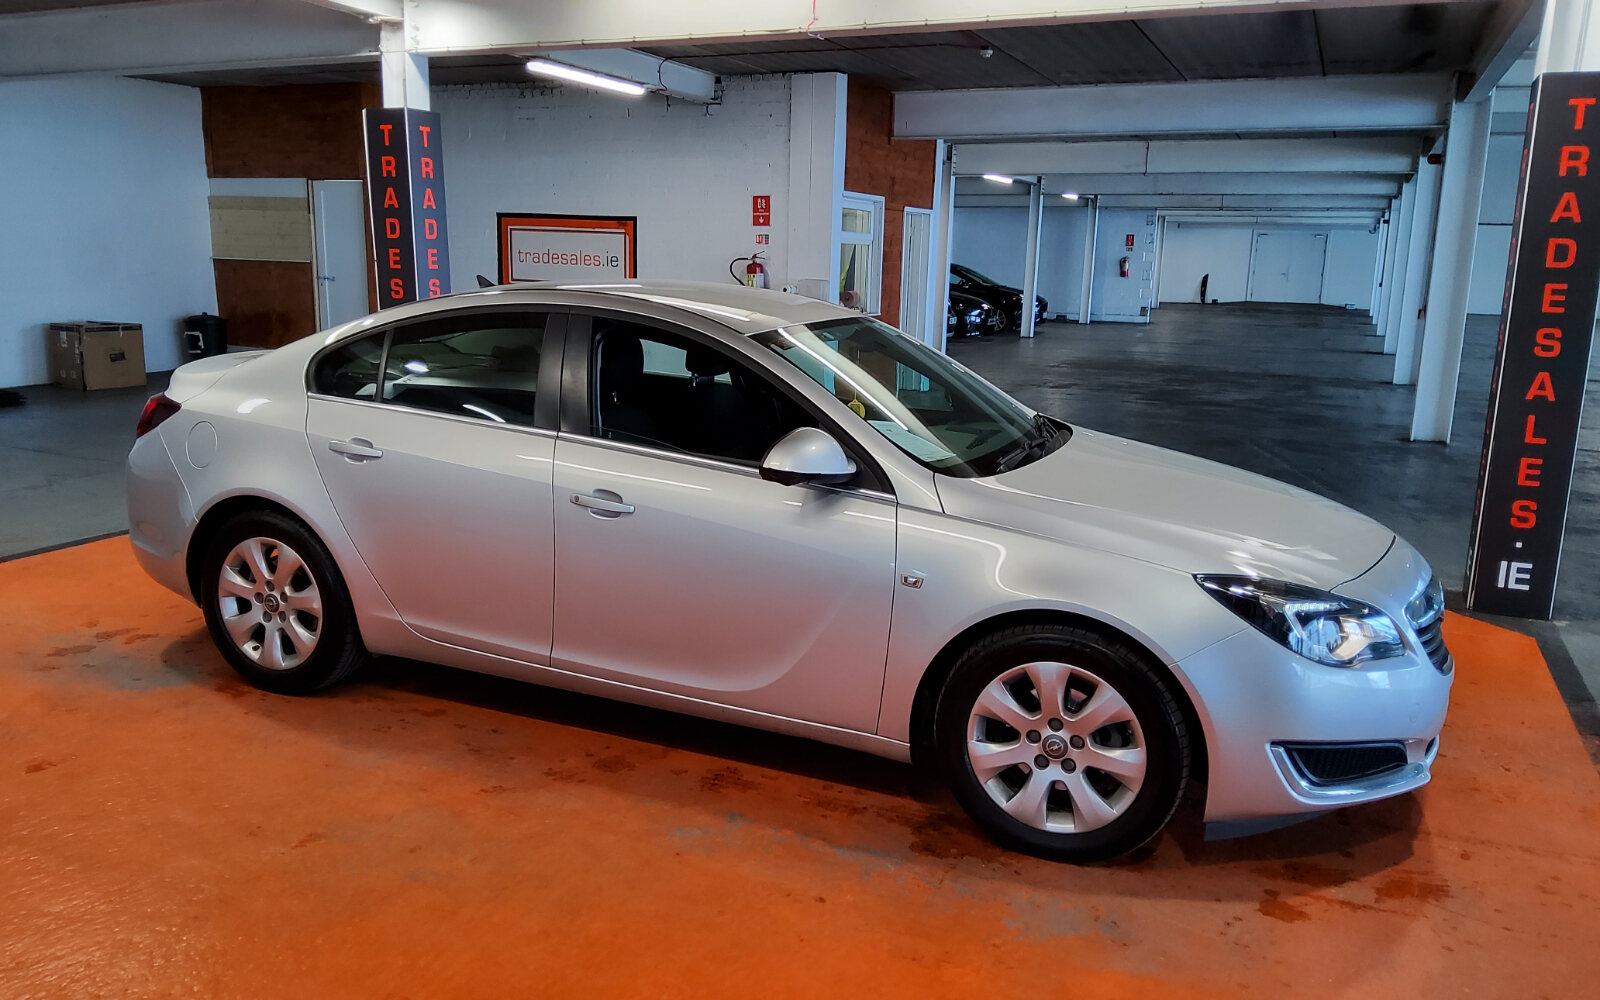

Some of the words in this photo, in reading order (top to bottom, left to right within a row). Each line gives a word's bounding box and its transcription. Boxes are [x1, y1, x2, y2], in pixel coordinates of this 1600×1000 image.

[379, 124, 404, 299] TRADES
[418, 125, 441, 299] TRADES
[517, 248, 619, 268] tradesales.ie
